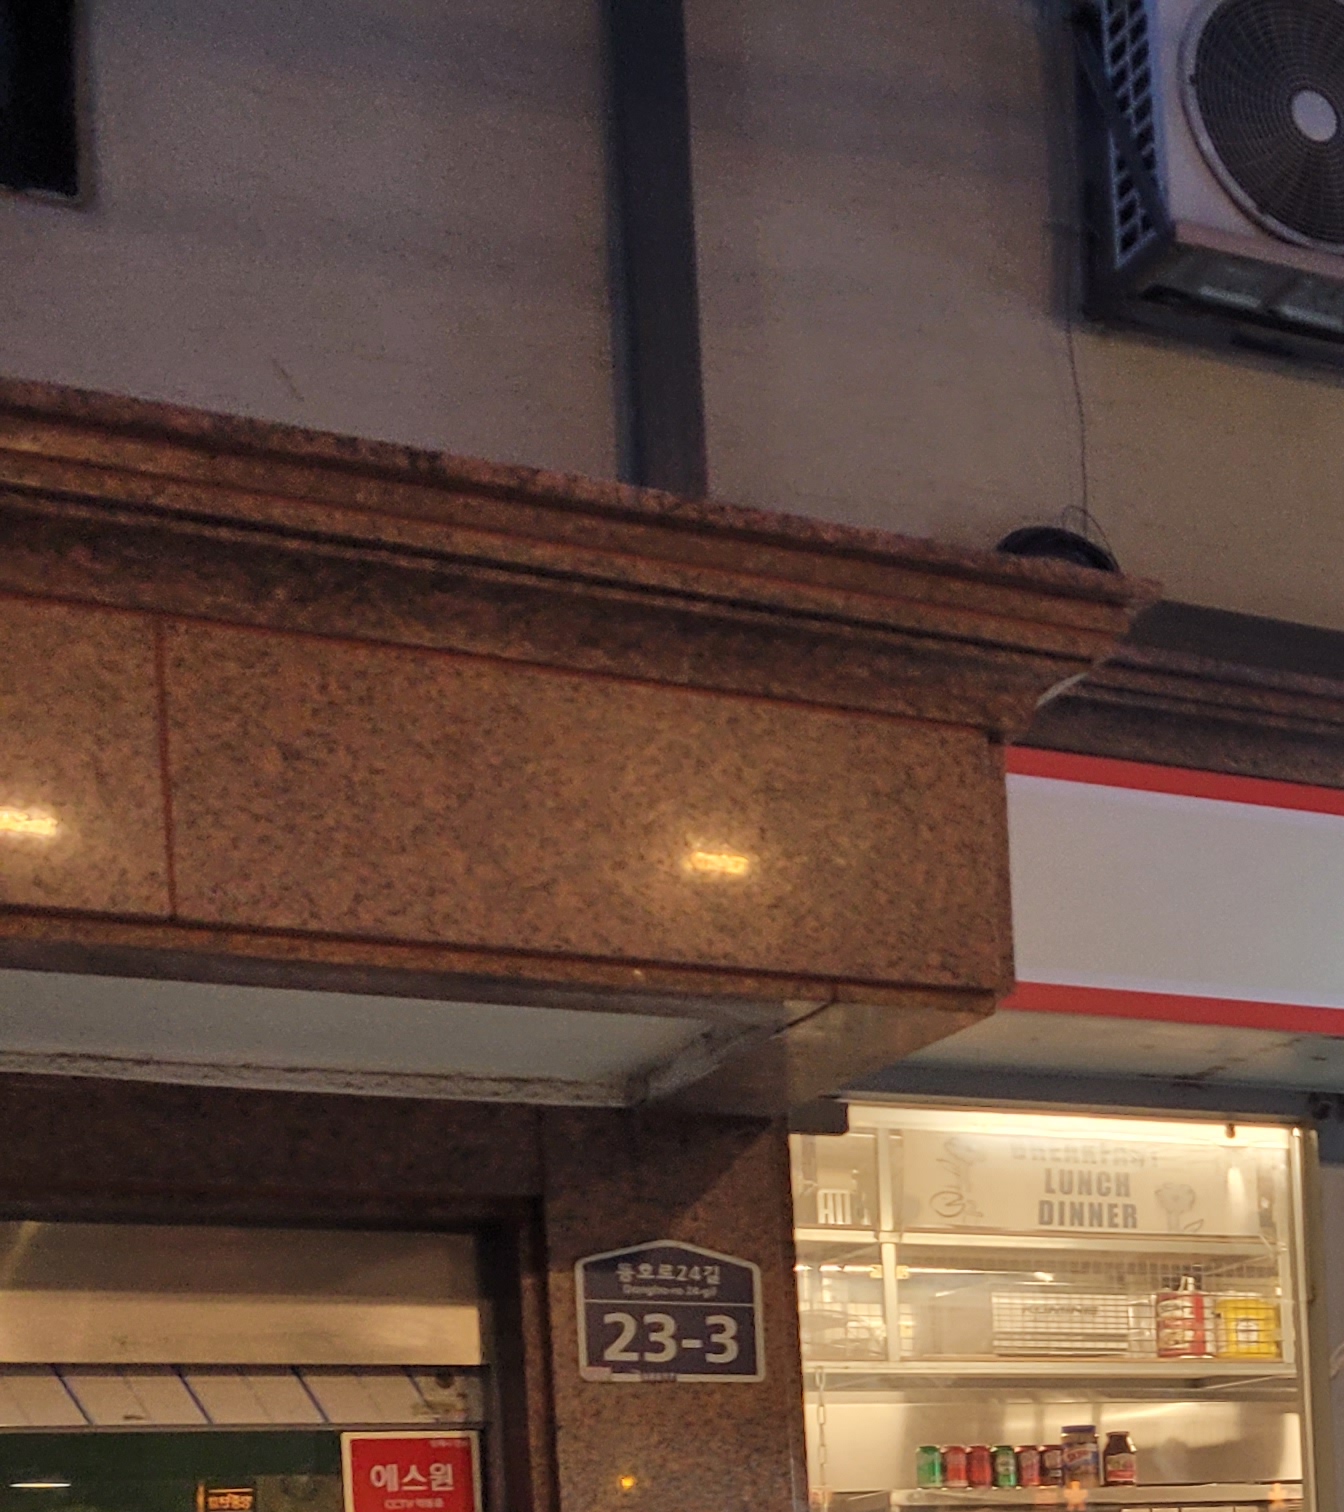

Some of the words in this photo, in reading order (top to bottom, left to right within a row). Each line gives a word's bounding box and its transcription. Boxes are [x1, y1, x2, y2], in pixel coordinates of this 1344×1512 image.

[1044, 1167, 1131, 1198] LUNCH
[1038, 1199, 1138, 1229] DINNER
[603, 1311, 740, 1364] 23-3
[369, 1462, 455, 1493] 에스원
